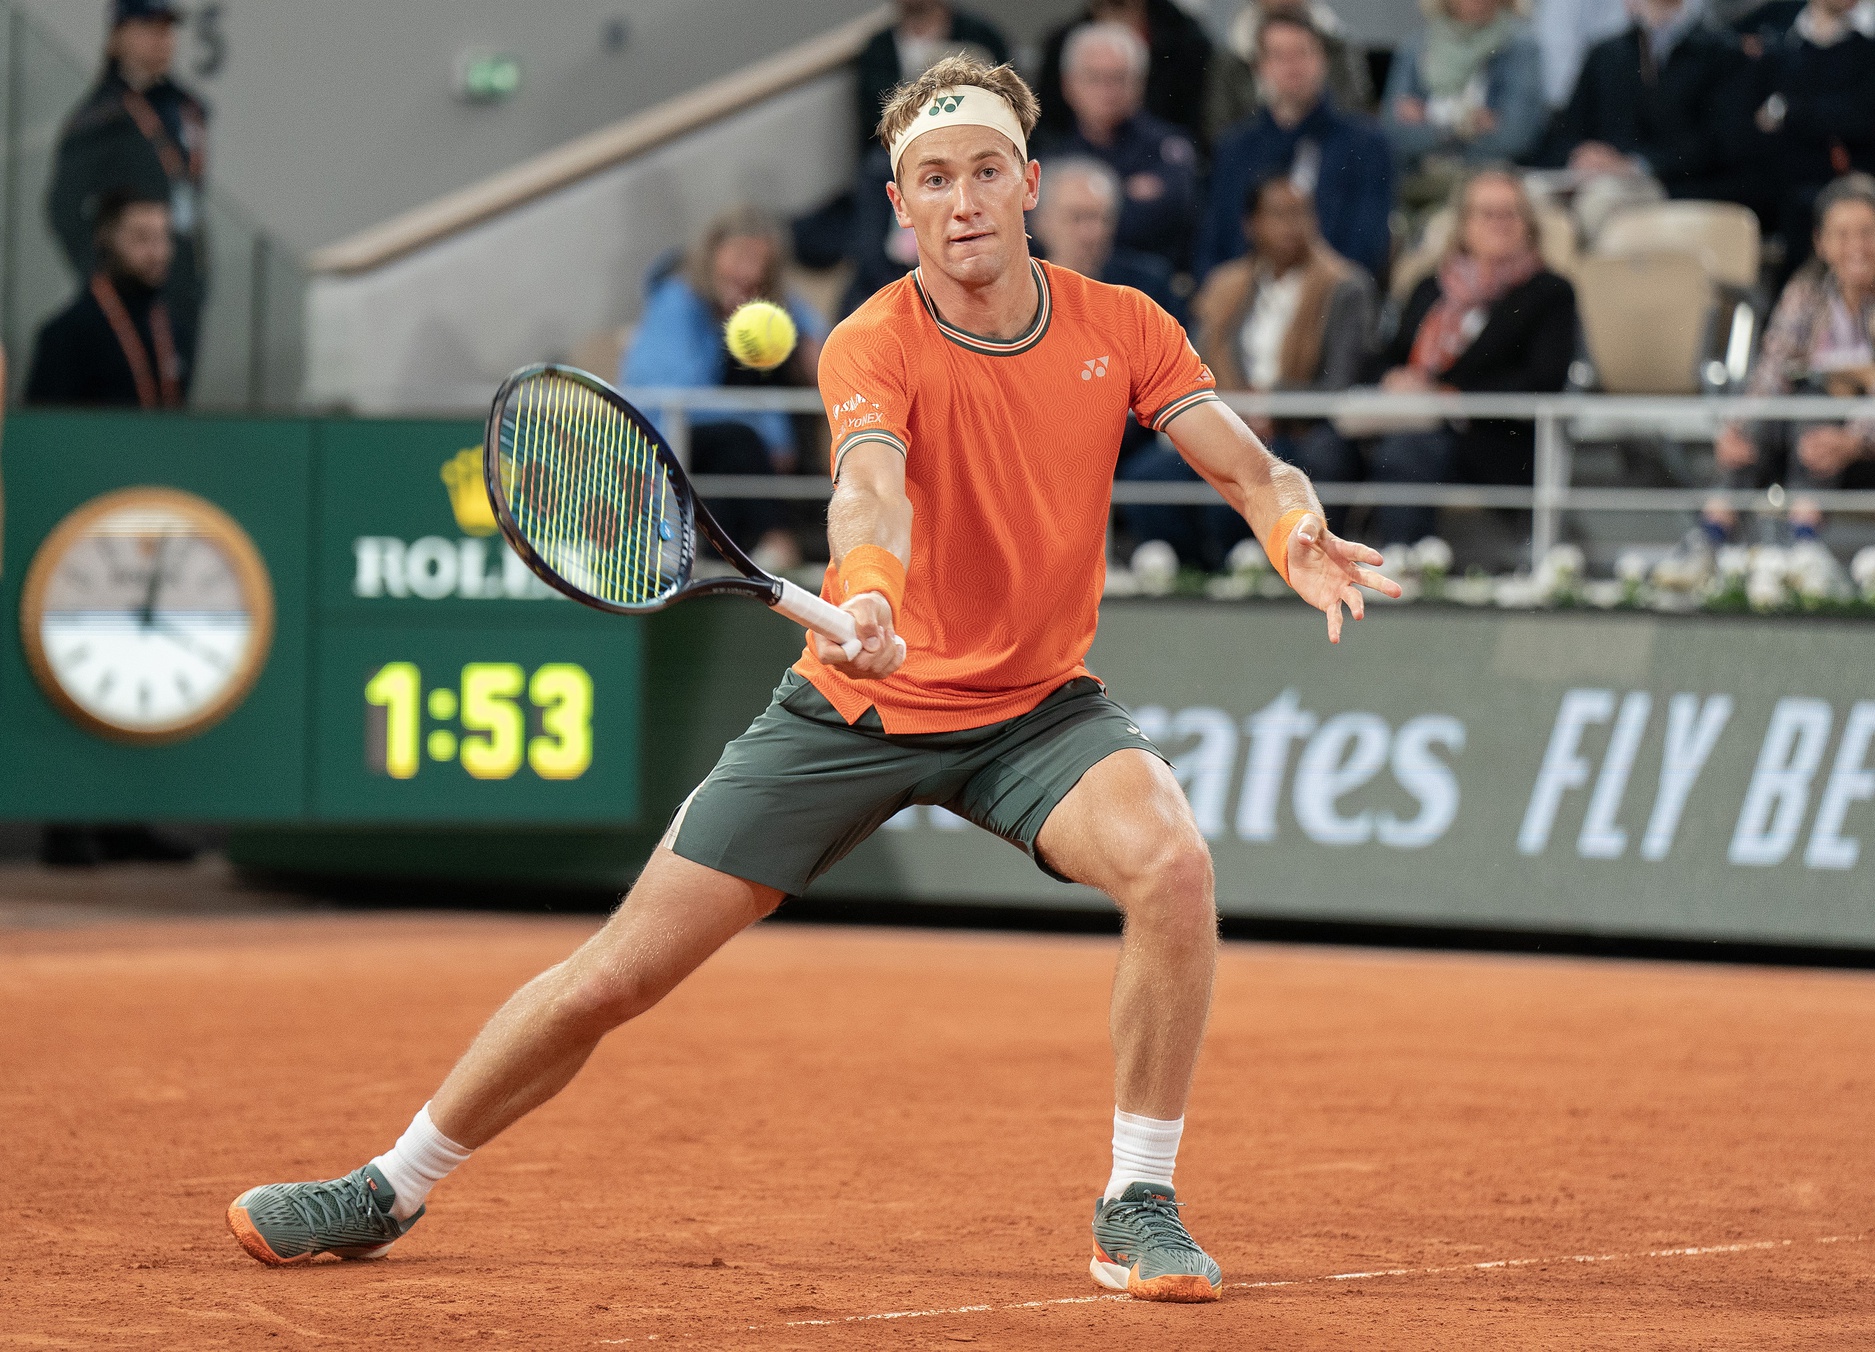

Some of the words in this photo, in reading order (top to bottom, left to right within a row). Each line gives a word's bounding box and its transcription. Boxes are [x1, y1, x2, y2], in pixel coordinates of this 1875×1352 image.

[847, 411, 883, 428] YONEX
[365, 661, 594, 779] 1:53
[1516, 688, 1733, 862] FLY
[1727, 696, 1875, 870] BE
